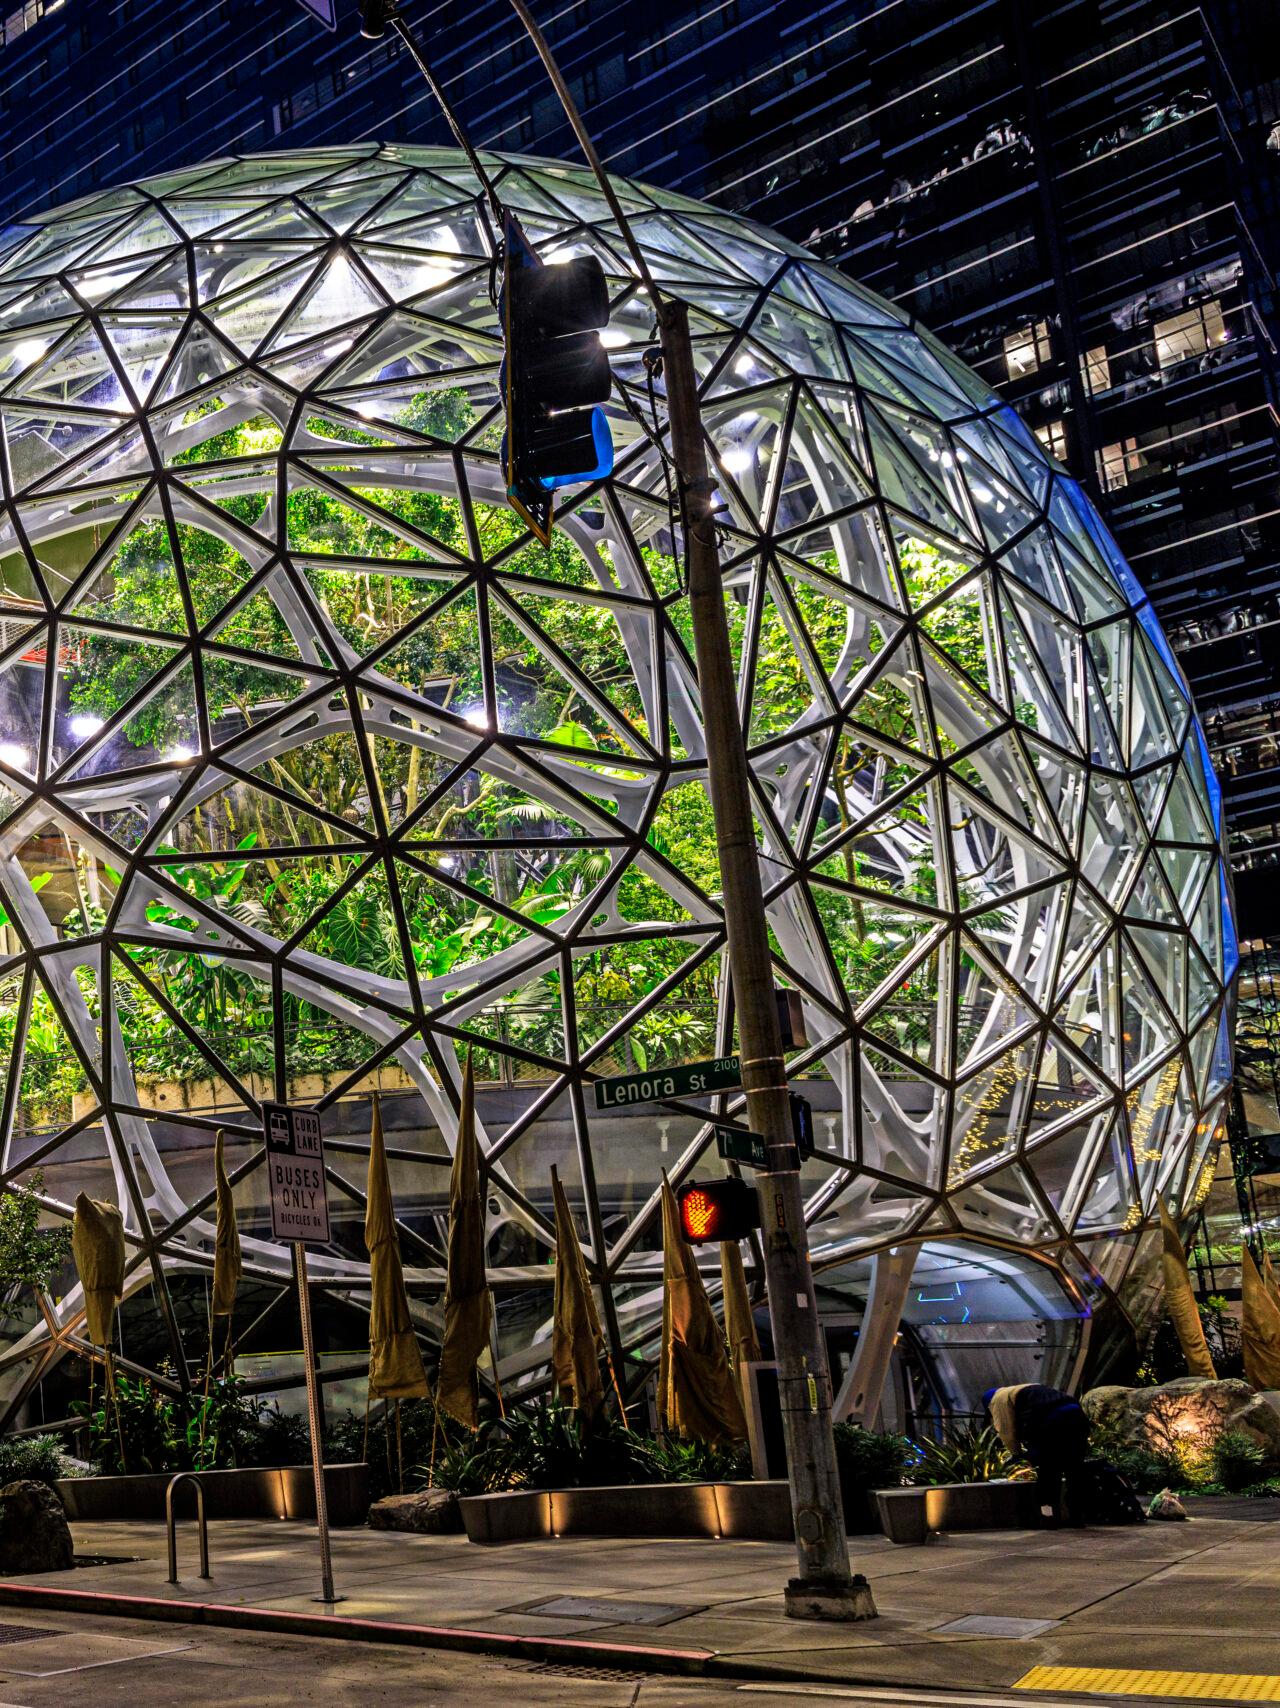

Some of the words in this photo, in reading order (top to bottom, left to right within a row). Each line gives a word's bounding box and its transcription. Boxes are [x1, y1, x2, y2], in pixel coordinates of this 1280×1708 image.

[714, 1058, 738, 1072] 2100
[602, 1077, 675, 1105] Lenora
[689, 1074, 707, 1091] St
[295, 1116, 318, 1134] CURB
[296, 1134, 319, 1151] LANE
[751, 1141, 764, 1159] Ave
[275, 1165, 320, 1189] BUSES
[282, 1188, 316, 1210] ONLY
[280, 1212, 311, 1227] BICYCLES
[313, 1215, 322, 1228] OK
